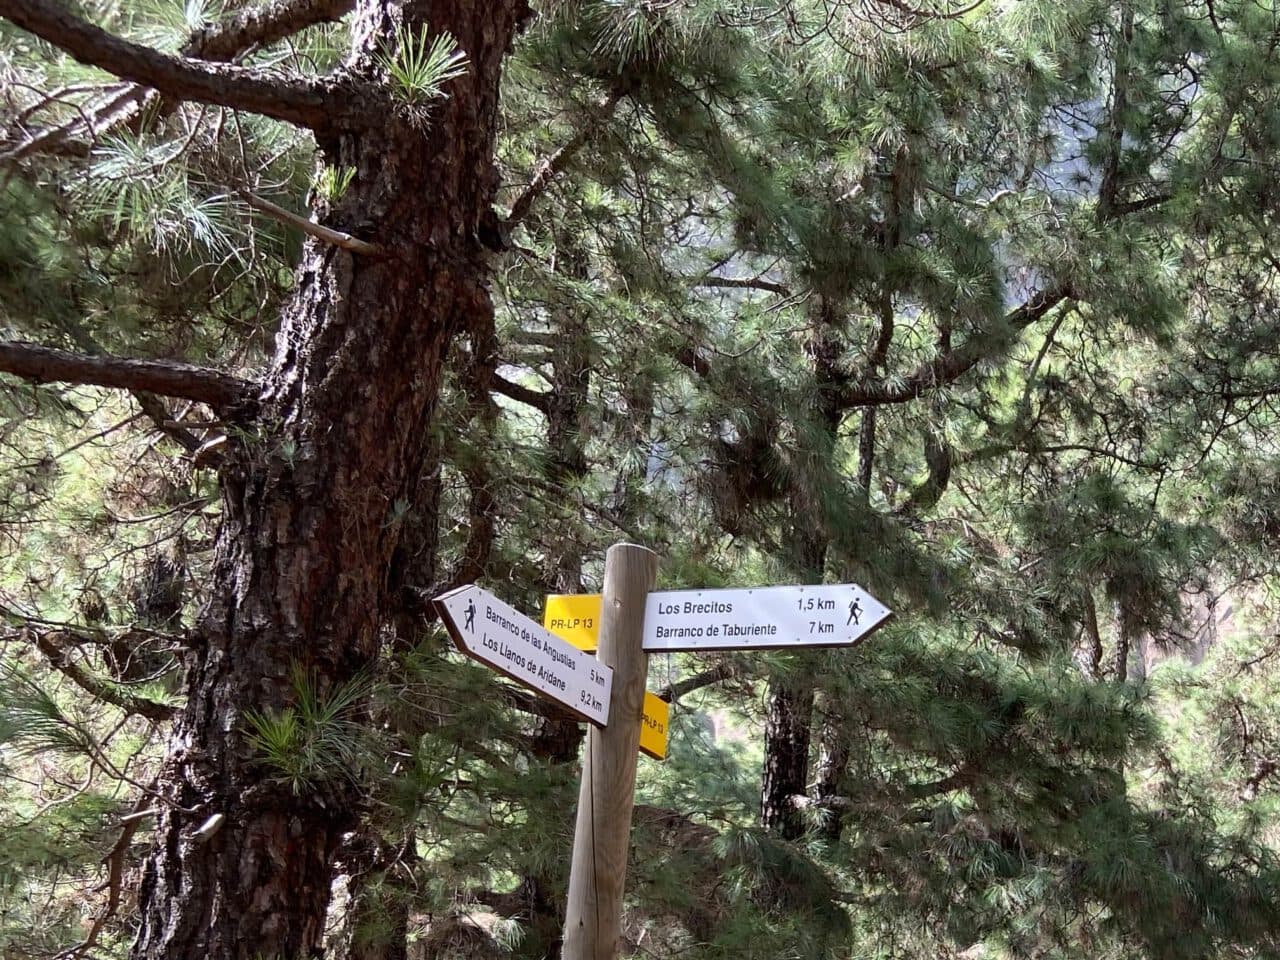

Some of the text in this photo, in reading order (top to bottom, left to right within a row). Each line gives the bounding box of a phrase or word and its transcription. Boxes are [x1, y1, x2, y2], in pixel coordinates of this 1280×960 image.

[658, 597, 835, 615] Los Brecitos 1,5 km
[550, 618, 593, 630] PR-LP 13
[656, 620, 835, 638] Barranco de Taburiente 7 km
[486, 605, 606, 687] Barranco de las Angustias 5 km
[482, 632, 603, 713] Los Llanos de Aridane 9,2 km
